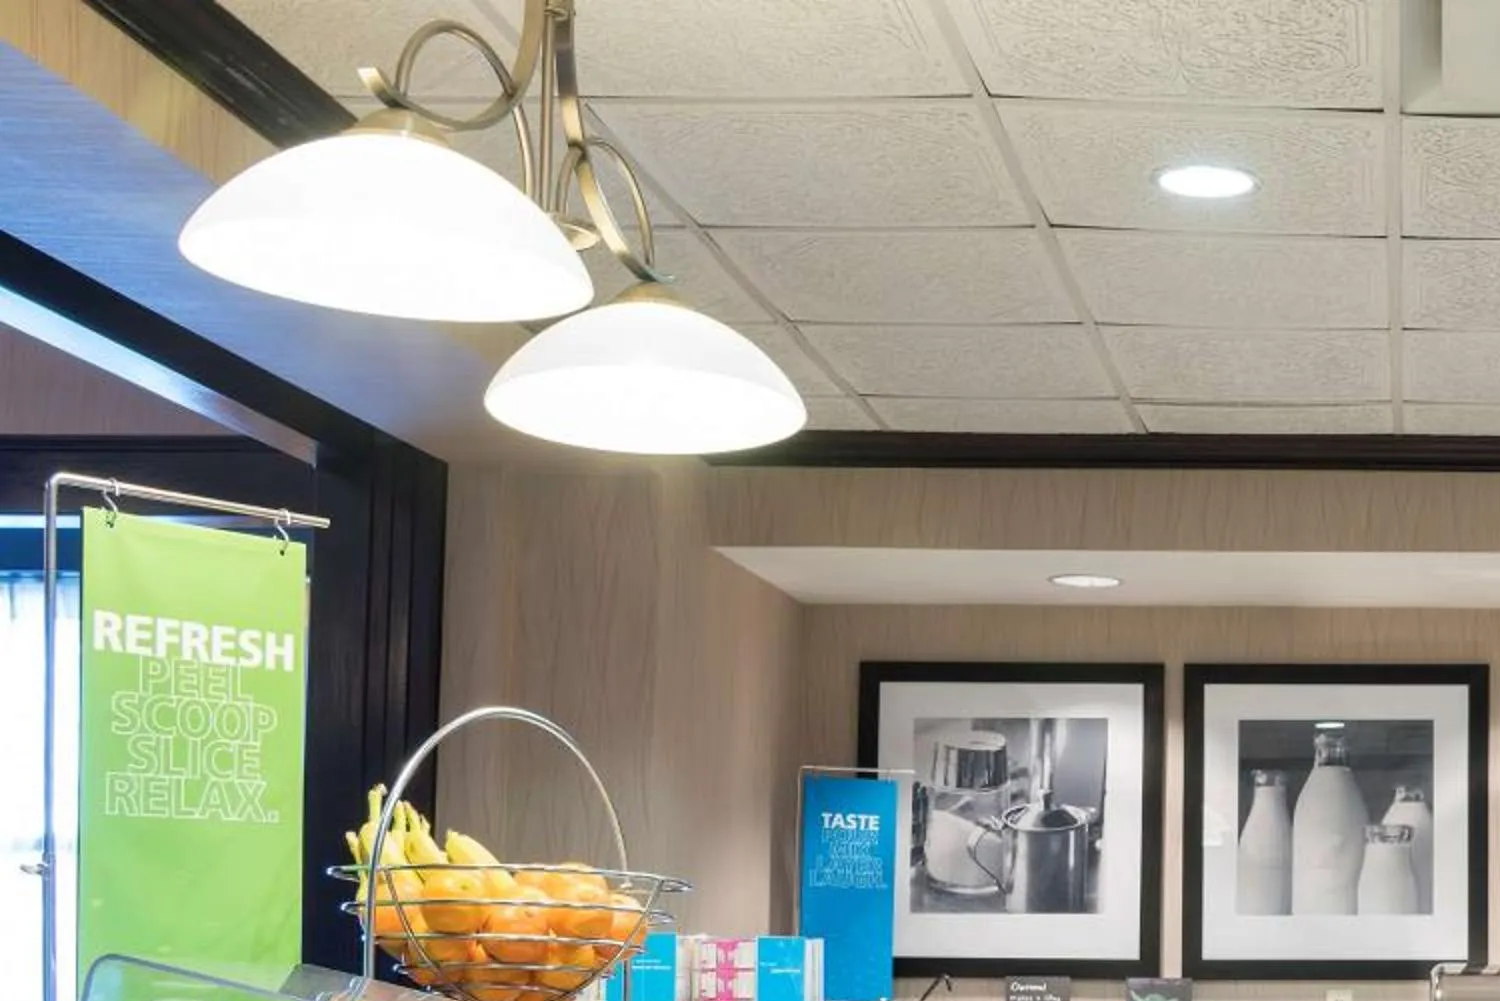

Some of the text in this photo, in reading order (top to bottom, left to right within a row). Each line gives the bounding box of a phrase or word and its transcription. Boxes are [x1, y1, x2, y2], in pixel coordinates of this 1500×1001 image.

[92, 609, 296, 673] REFRESH
[138, 653, 254, 704] PEEL
[110, 690, 278, 746] SCOOP
[127, 732, 262, 784] SLICE
[105, 771, 280, 824] RELAX.
[821, 813, 881, 831] TASTE
